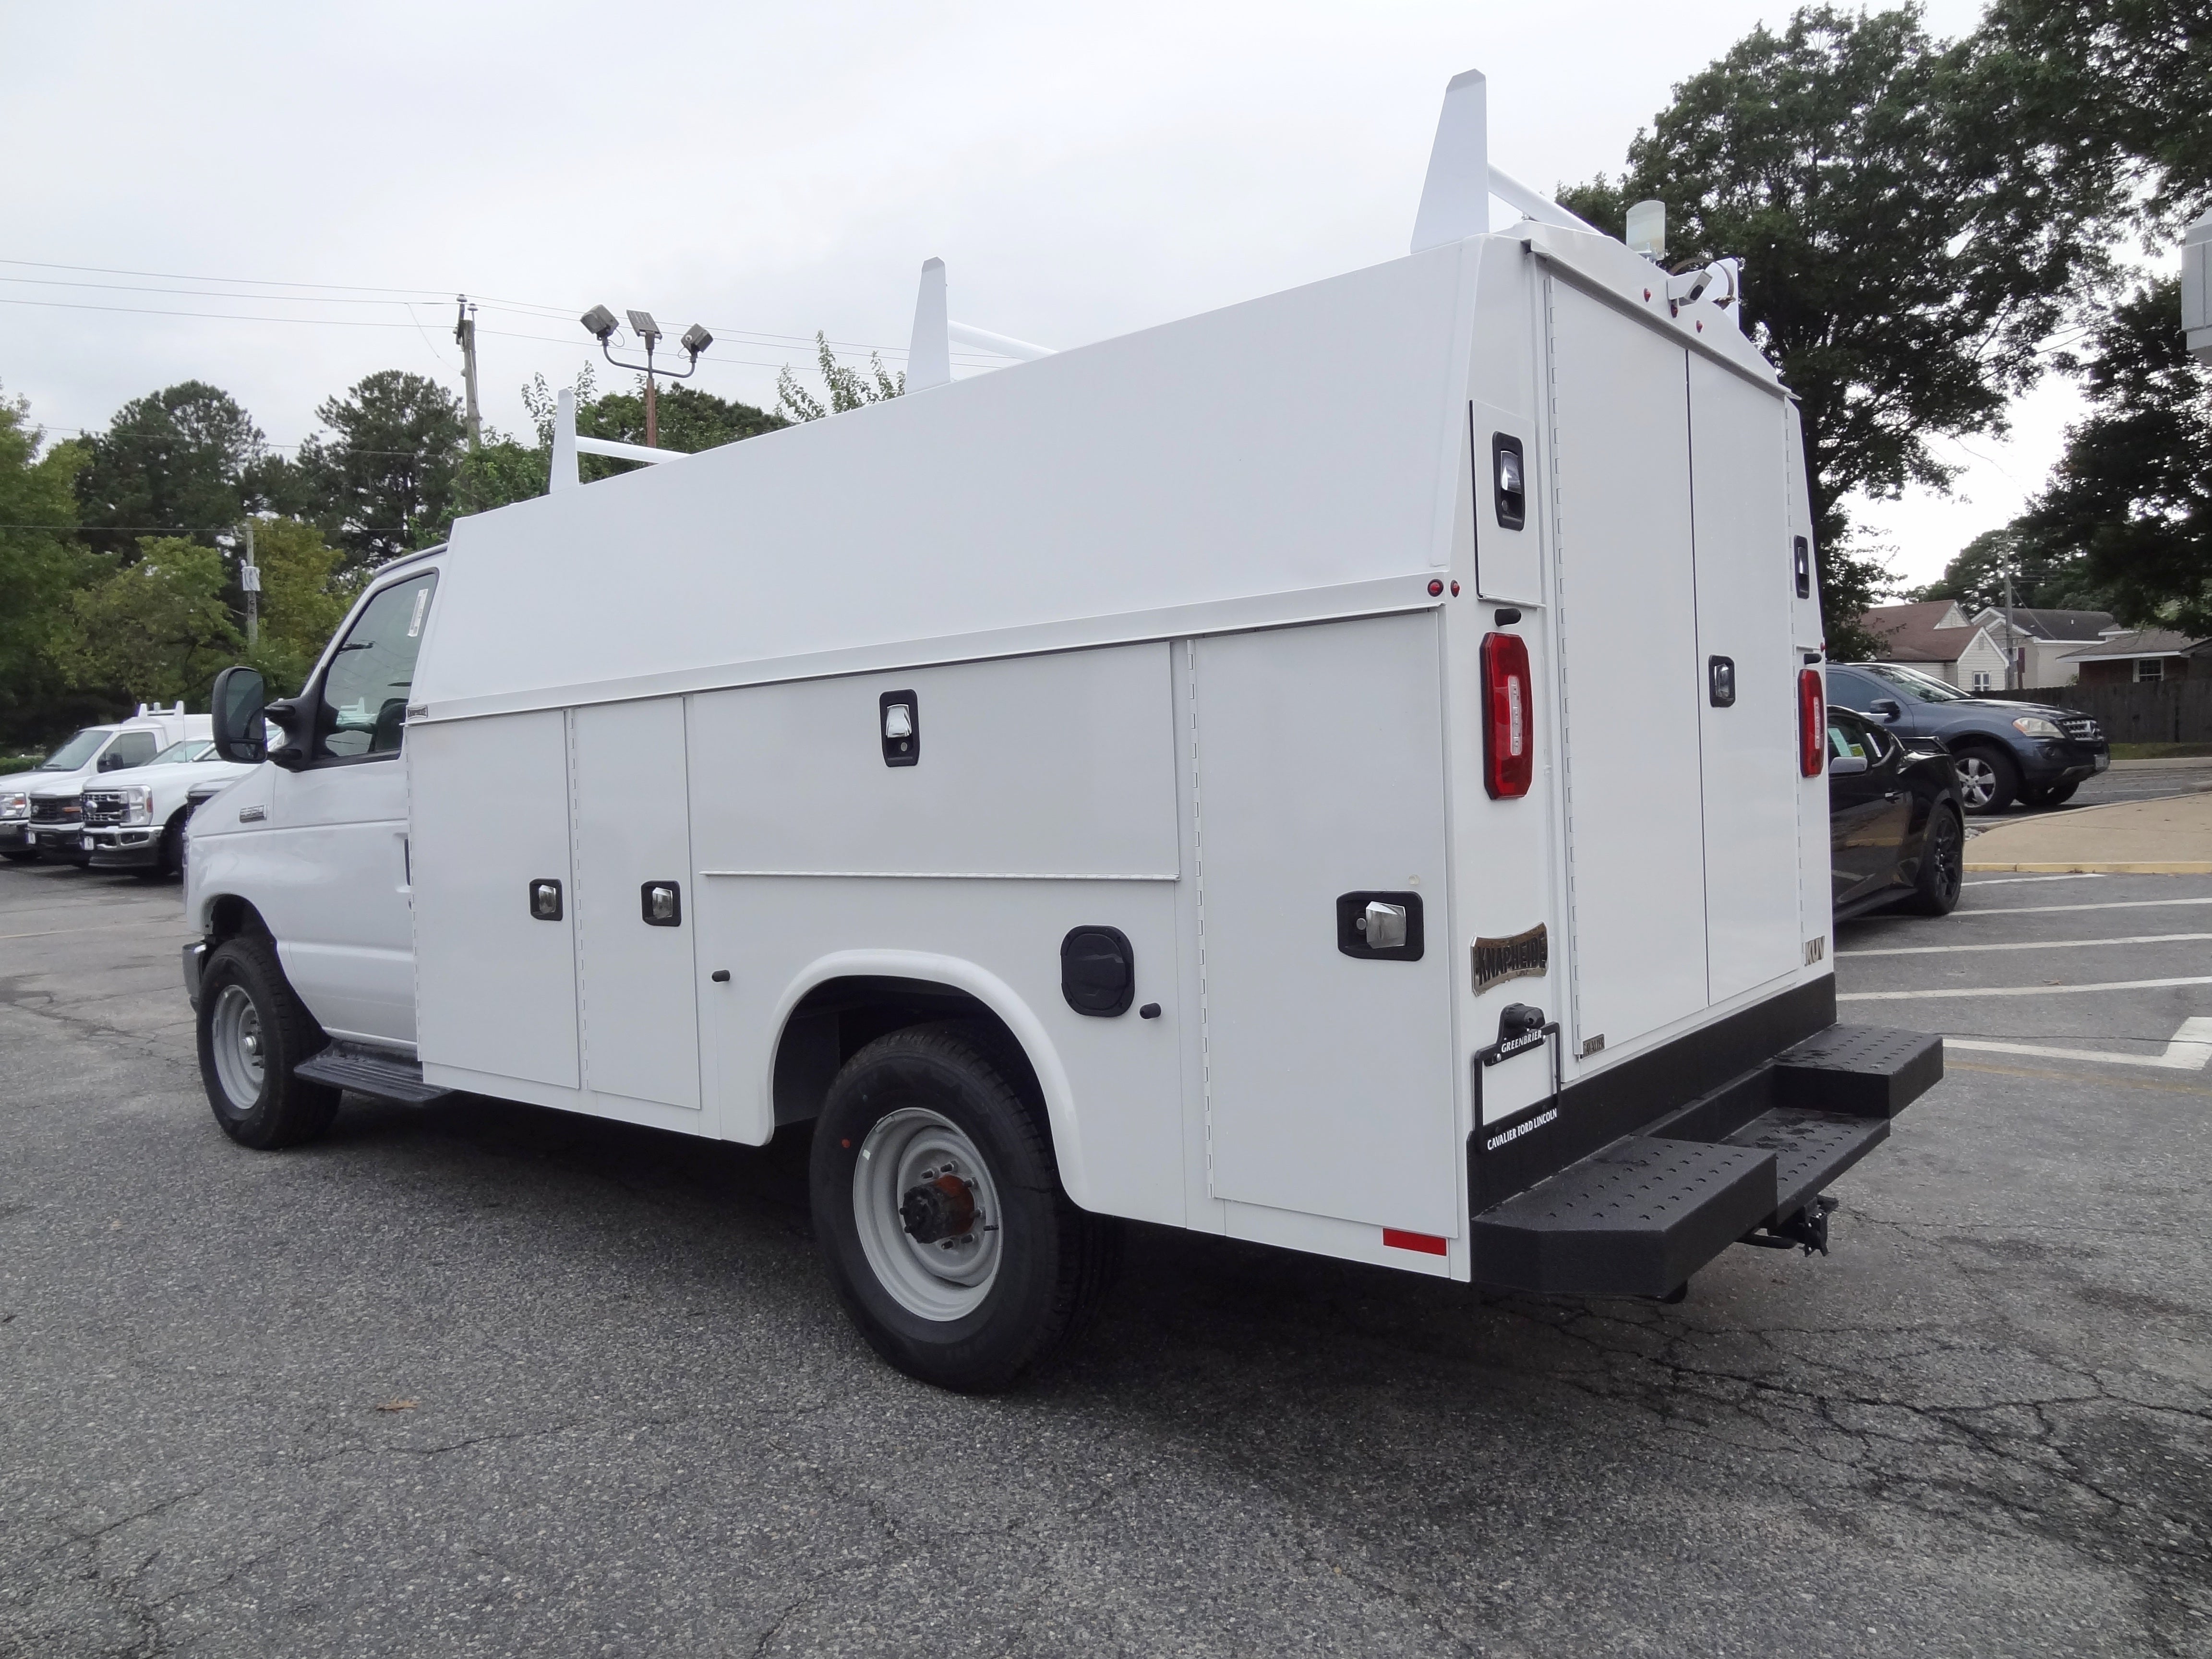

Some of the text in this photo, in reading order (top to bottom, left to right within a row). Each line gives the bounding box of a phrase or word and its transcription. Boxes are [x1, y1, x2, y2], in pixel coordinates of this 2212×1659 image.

[1475, 932, 1547, 986] KNAPHEIDE
[1805, 935, 1825, 966] KUV
[1501, 1030, 1542, 1053] GREENBRIER
[1487, 1108, 1557, 1150] CAVALIER FORD LINCOLN
